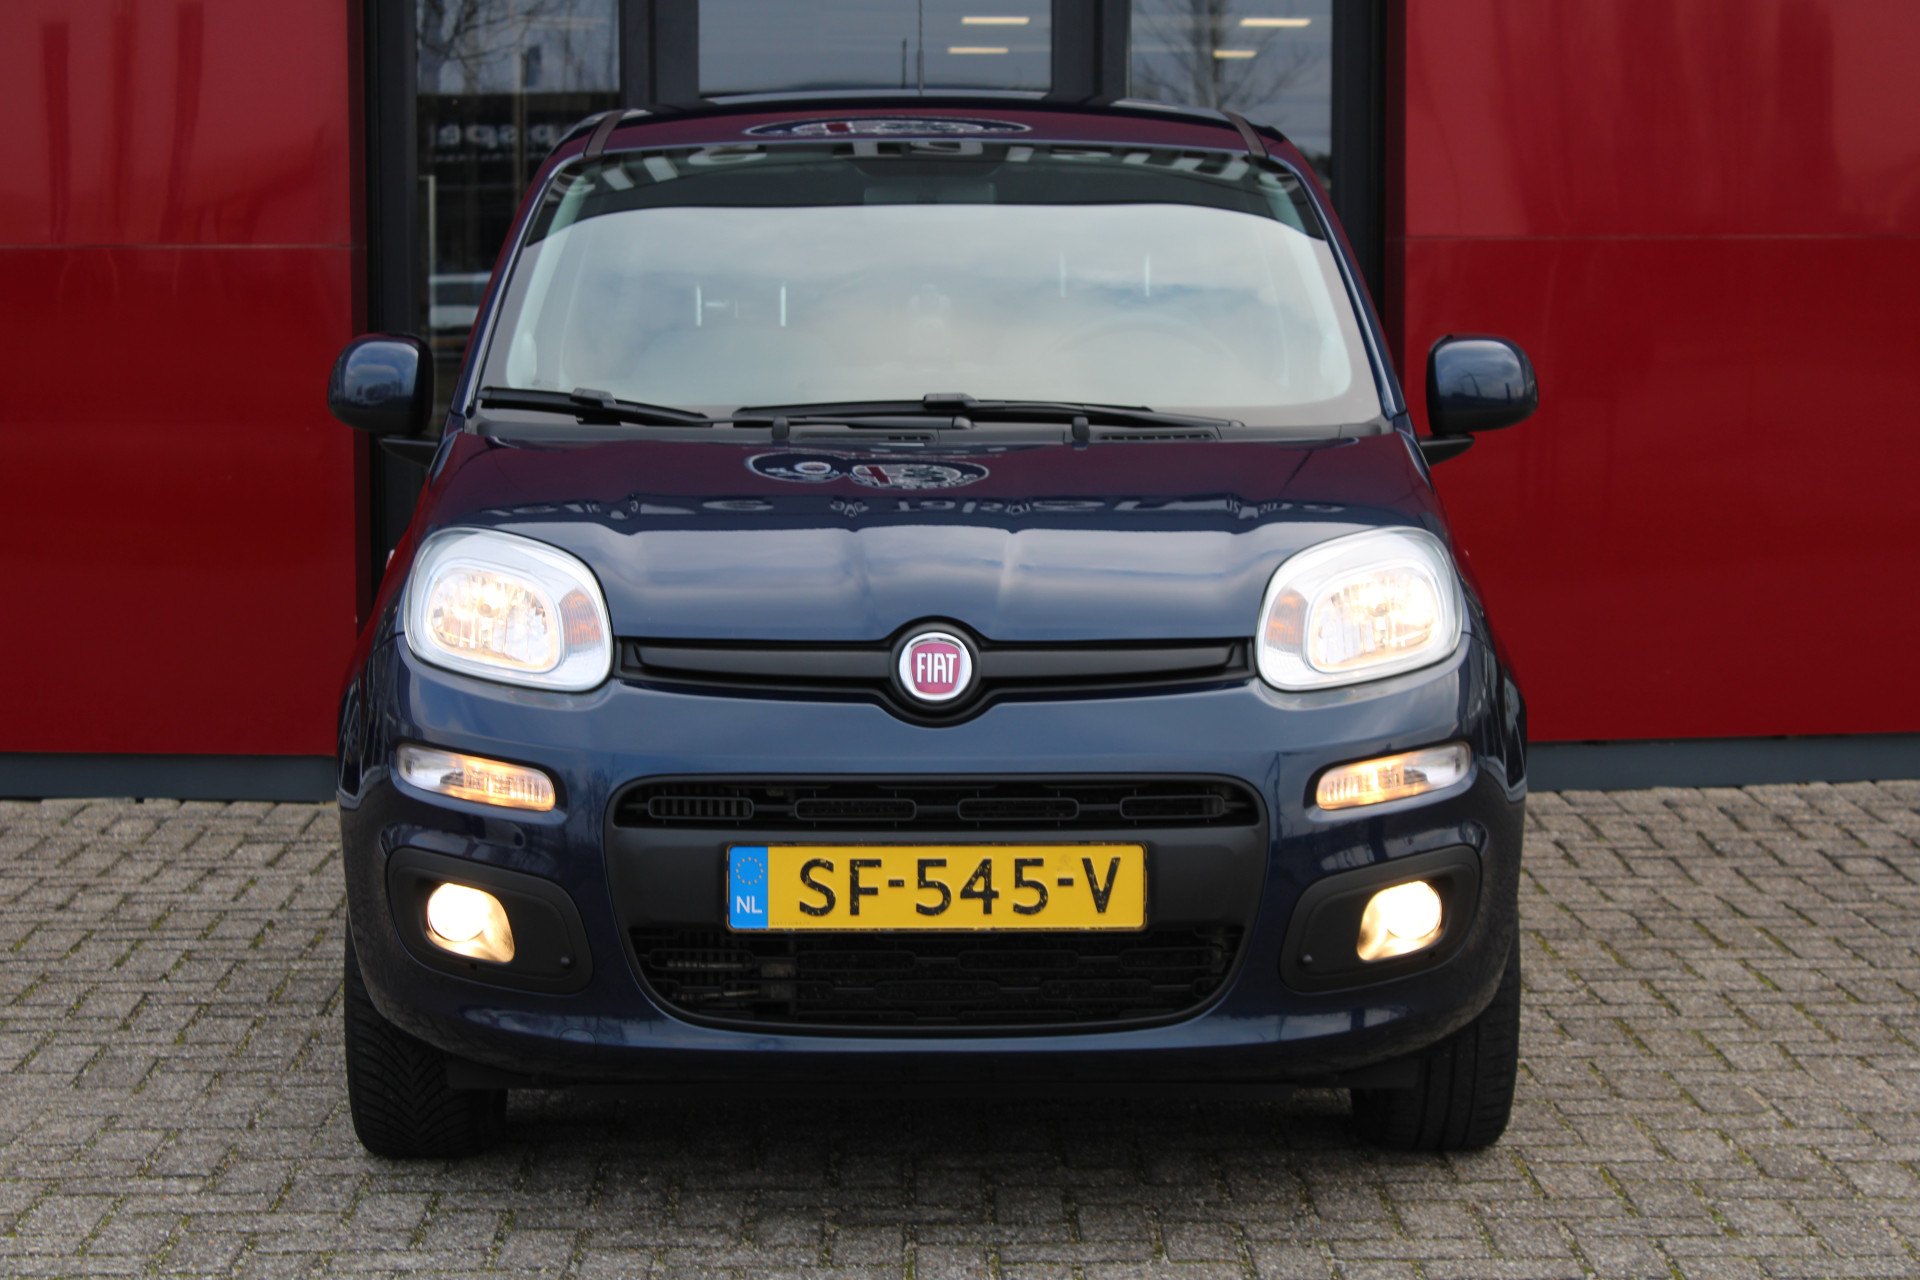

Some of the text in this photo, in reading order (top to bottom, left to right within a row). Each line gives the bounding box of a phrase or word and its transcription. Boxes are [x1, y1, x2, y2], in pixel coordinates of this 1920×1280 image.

[916, 651, 958, 684] FIAT
[798, 857, 1122, 916] SF-545-V
[736, 895, 763, 914] NL
